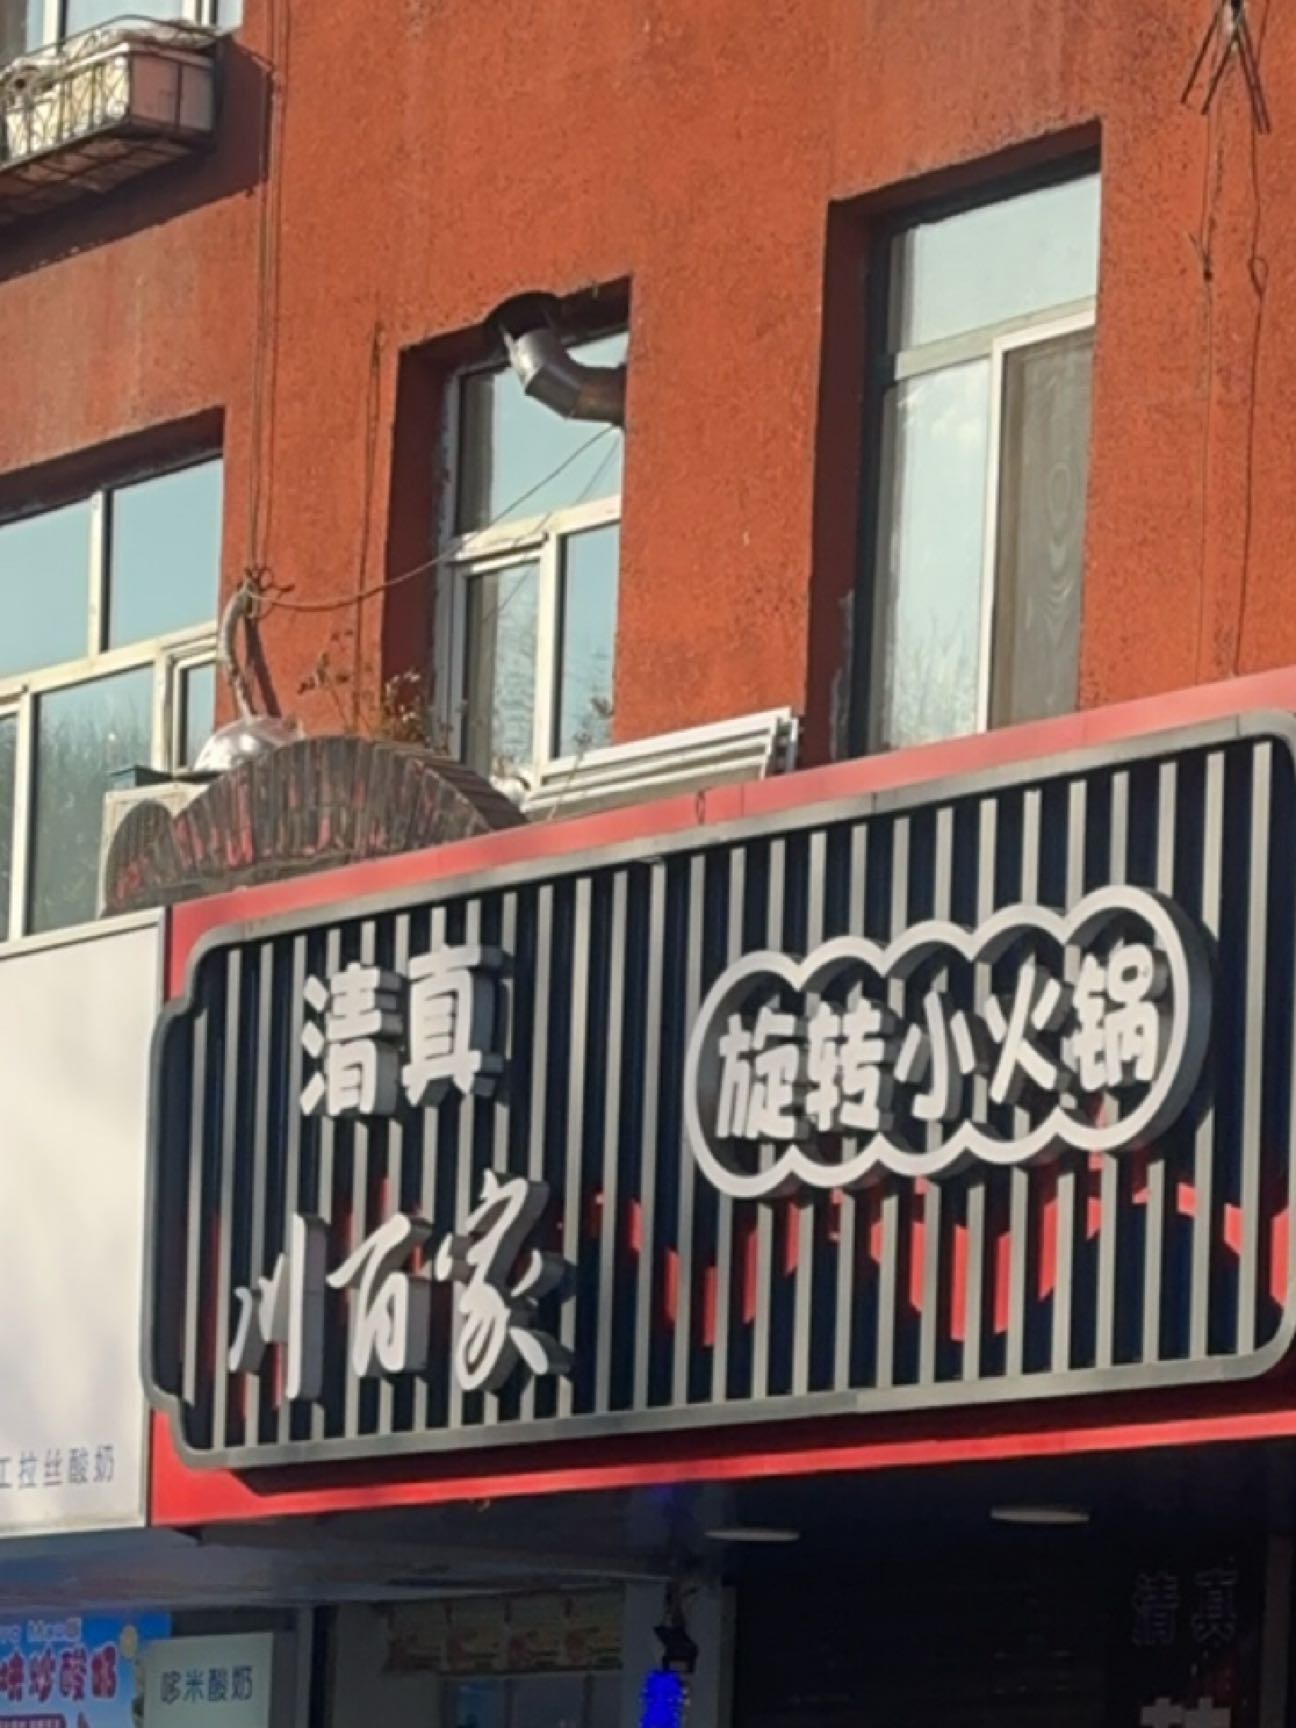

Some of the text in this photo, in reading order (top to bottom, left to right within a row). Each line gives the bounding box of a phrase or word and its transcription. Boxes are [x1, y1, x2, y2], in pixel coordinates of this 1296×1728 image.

[301, 943, 494, 1117] 清真
[715, 942, 1161, 1140] 旋转小火锅
[229, 1168, 556, 1401] 川百家
